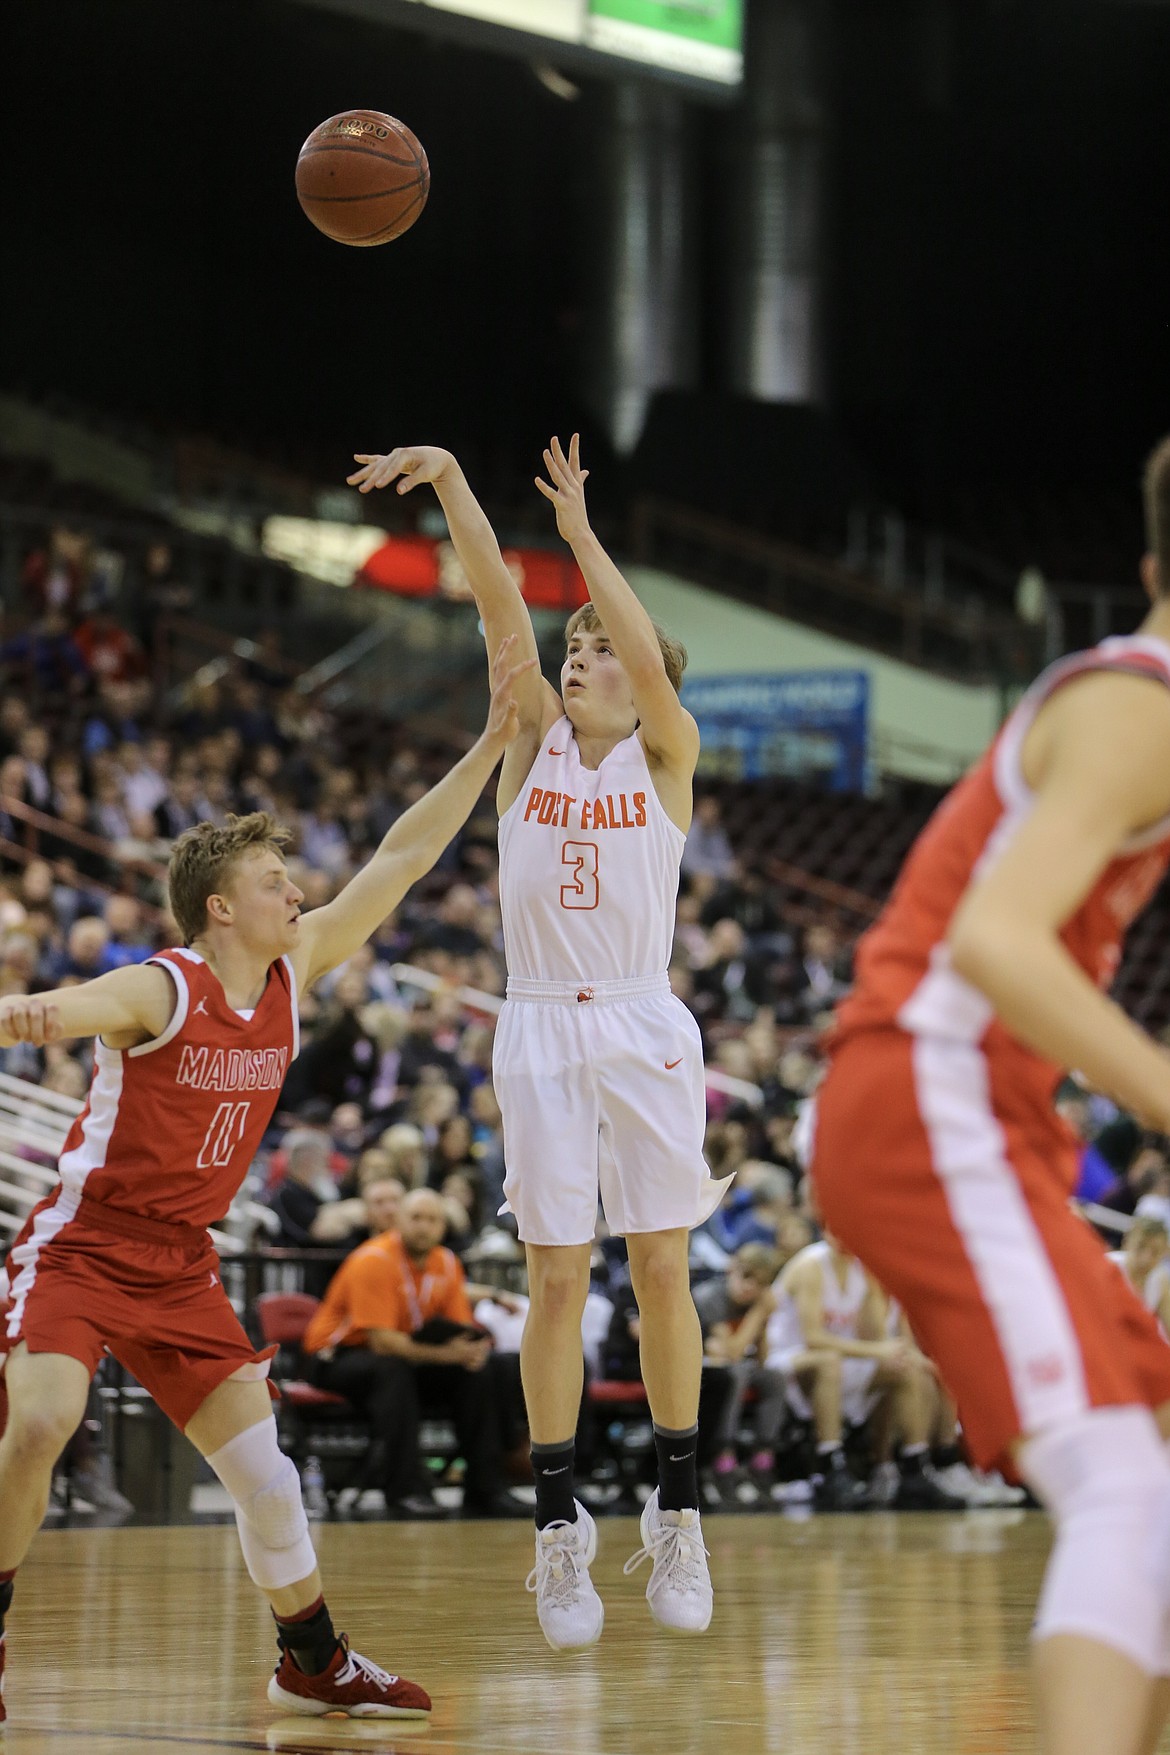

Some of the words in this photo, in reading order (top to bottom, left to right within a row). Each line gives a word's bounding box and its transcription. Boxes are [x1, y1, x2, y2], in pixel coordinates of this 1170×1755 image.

[336, 119, 389, 139] 1000
[580, 791, 647, 829] FALLS
[560, 840, 599, 910] 3
[176, 1044, 288, 1091] MADISON
[196, 1101, 251, 1168] 11
